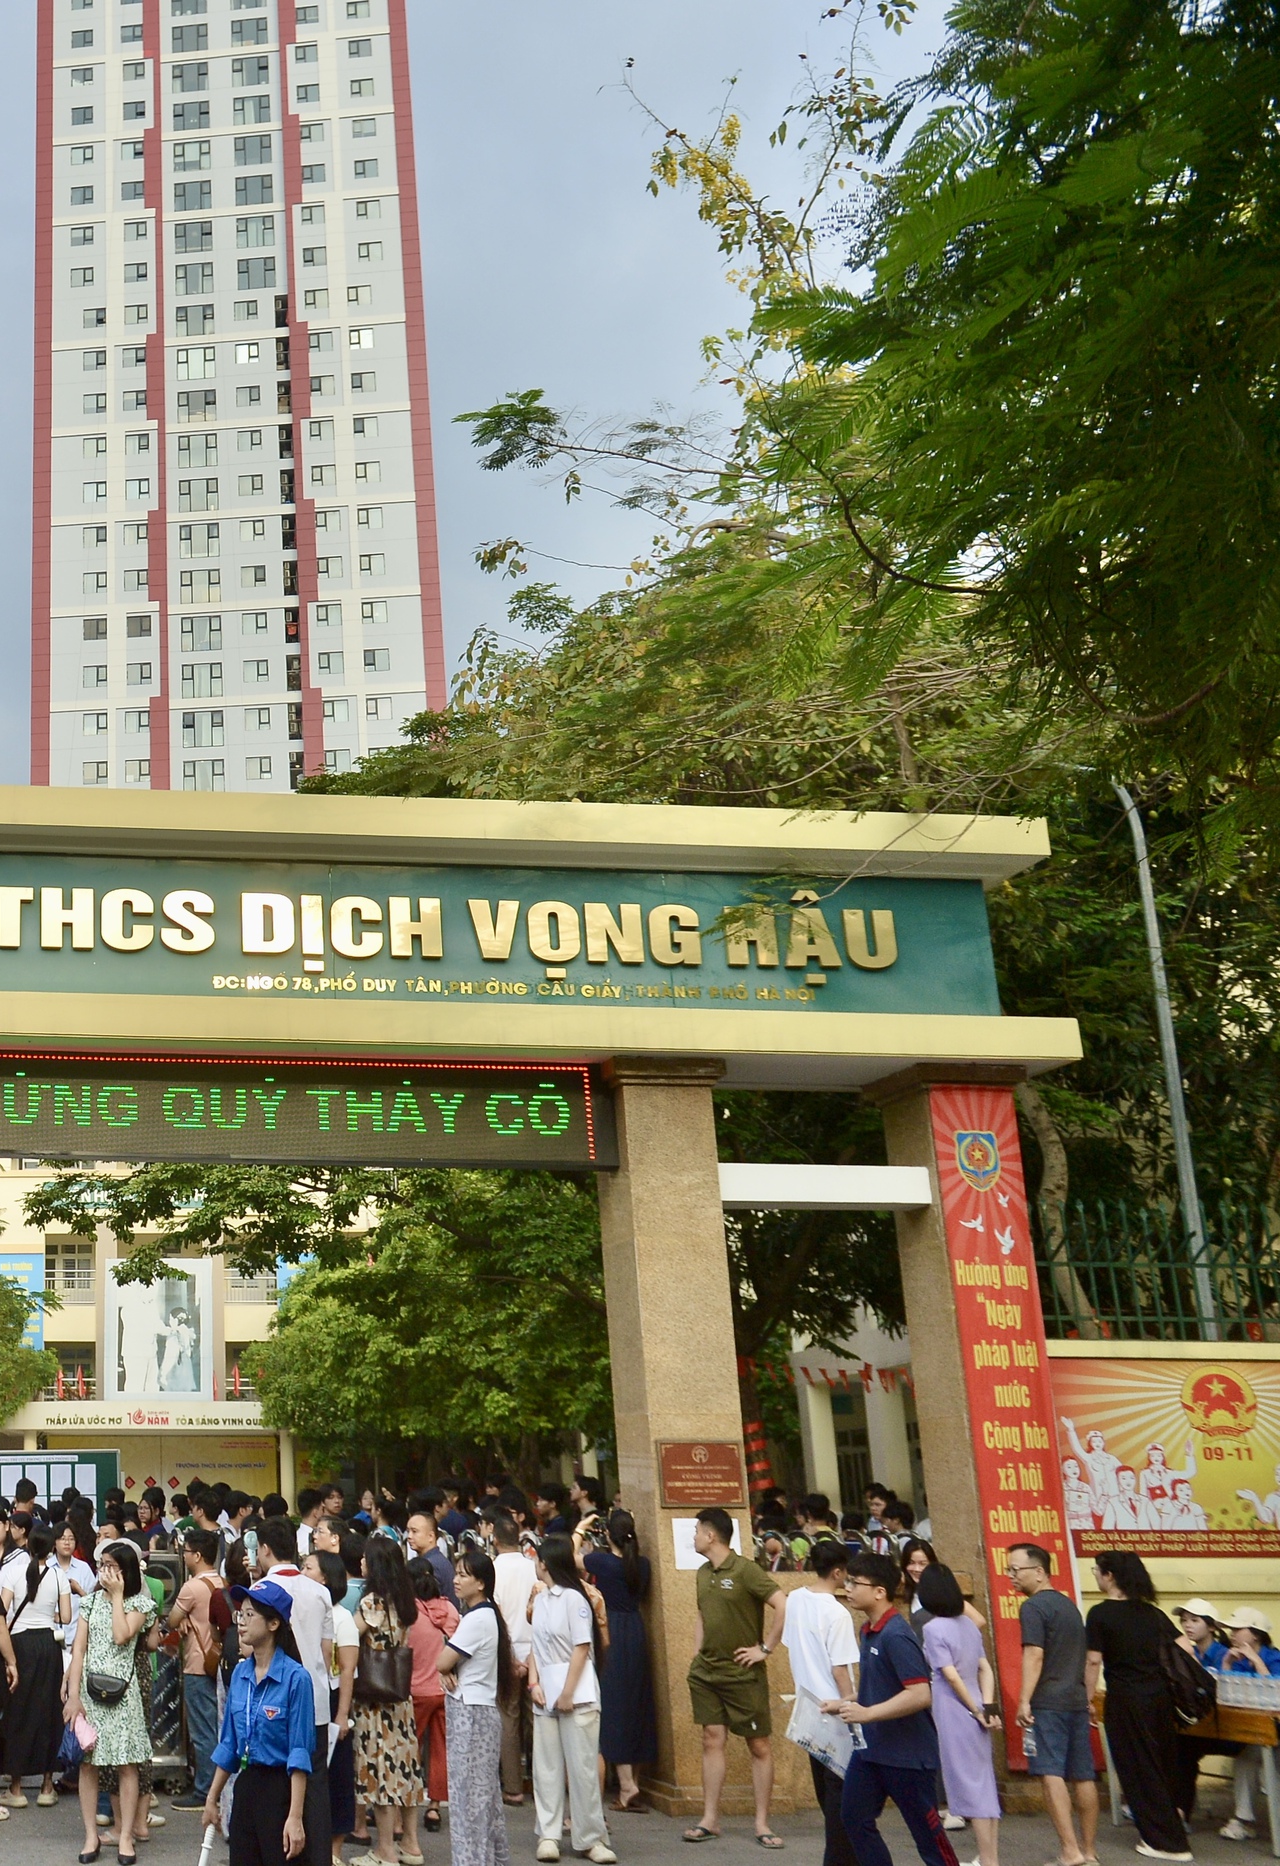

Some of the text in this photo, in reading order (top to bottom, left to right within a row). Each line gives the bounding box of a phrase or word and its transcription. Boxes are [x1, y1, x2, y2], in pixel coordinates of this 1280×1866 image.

[241, 892, 443, 972] DỊCH
[466, 899, 702, 979] VỌNG
[723, 889, 898, 985] HẬU
[362, 978, 397, 992] DUY
[484, 1083, 571, 1135] CÔ
[955, 1256, 1029, 1289] Hưởng ứng
[972, 1340, 1039, 1373] pháp luật
[994, 1380, 1031, 1409] nước
[983, 1420, 1049, 1457] Cộng hòa
[1203, 1446, 1253, 1461] 09-11
[998, 1462, 1044, 1496] xã hội
[989, 1503, 1060, 1537] chủ nghĩa
[1081, 1531, 1107, 1541] SỐNG
[1107, 1532, 1120, 1541] VÀ
[1120, 1532, 1140, 1541] LÀM
[1141, 1532, 1161, 1542] VIỆC
[1162, 1533, 1187, 1542] THEO
[1135, 1542, 1160, 1552] NGÀY
[1161, 1542, 1185, 1551] PHÁP
[1186, 1542, 1208, 1553] LUẬT
